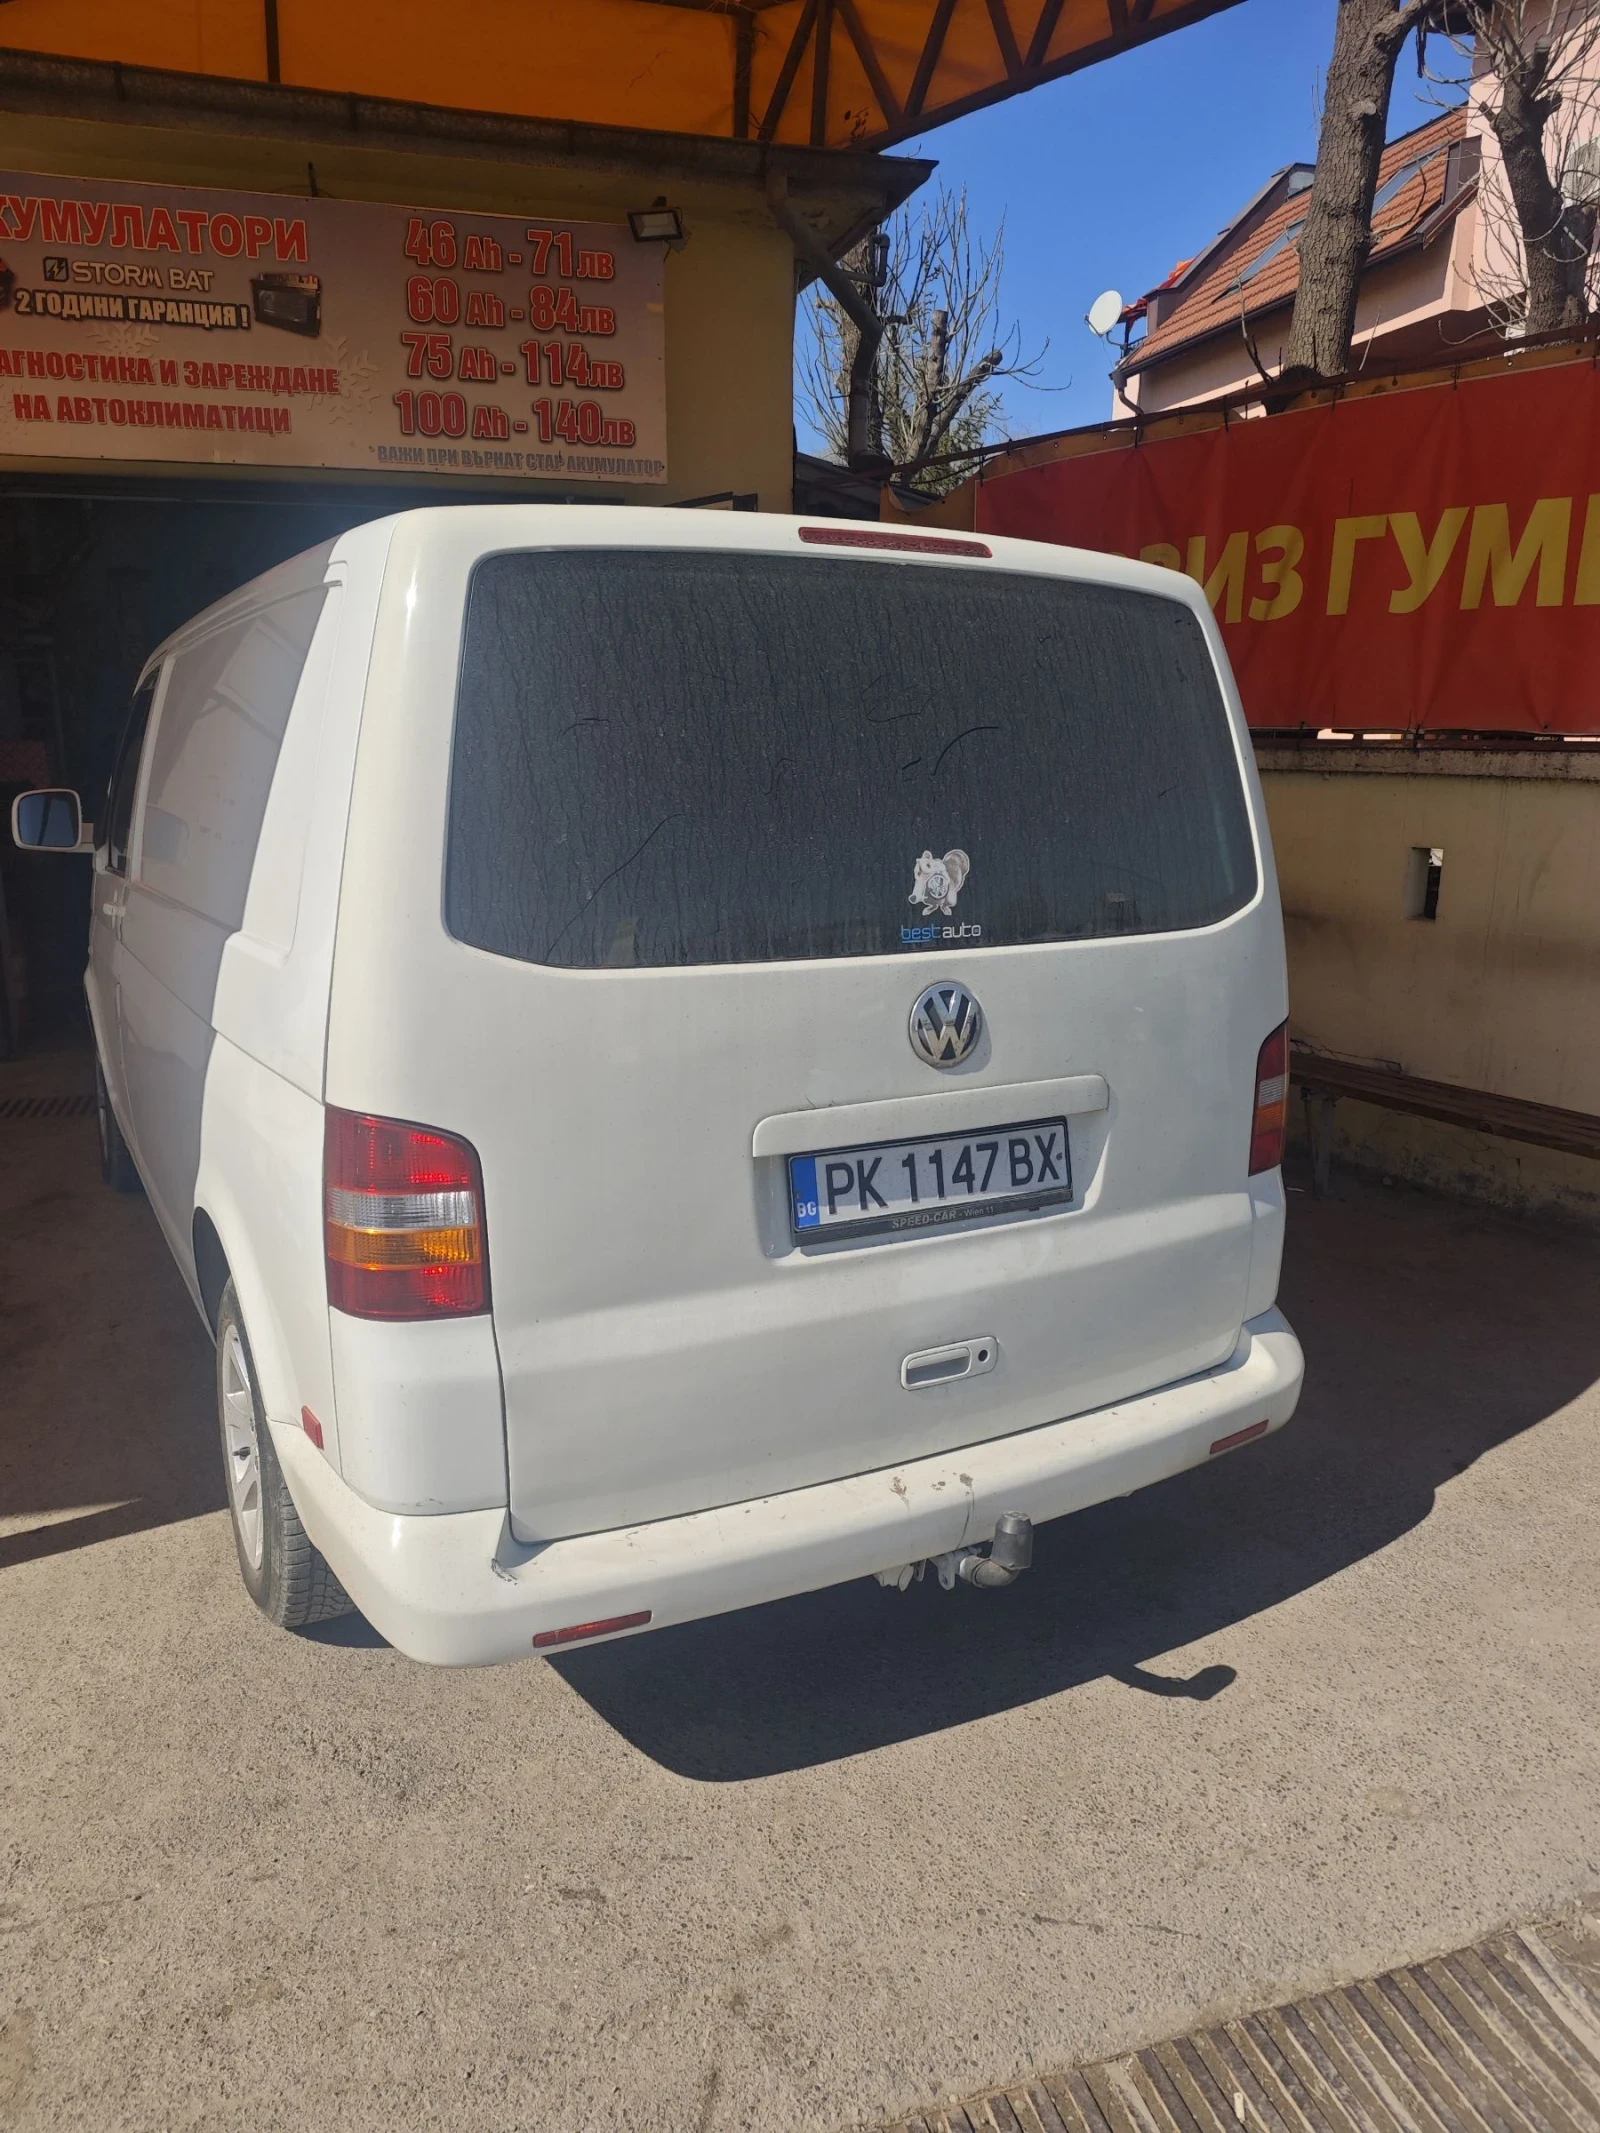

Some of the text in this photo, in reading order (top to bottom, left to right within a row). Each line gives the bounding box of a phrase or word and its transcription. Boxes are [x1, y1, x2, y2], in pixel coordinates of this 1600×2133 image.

[405, 219, 457, 267] 46
[464, 236, 502, 271] Ah
[71, 261, 214, 291] STORM BAT
[16, 291, 31, 313] 2
[36, 292, 124, 319] ГОДИНИ
[407, 276, 459, 323] 60
[466, 293, 504, 327] Ah
[159, 358, 179, 386] И
[183, 361, 342, 396] ЗАРЕЖДАНЕ
[402, 332, 453, 378] 75
[460, 348, 496, 380] Ah
[13, 394, 292, 436] НА АВТОКЛИМАТИЦИ
[394, 391, 467, 436] 100
[473, 406, 510, 439] Ah
[426, 448, 460, 467] ПРИ
[461, 450, 523, 470] ВЪРНАТ
[525, 453, 564, 472] СТАР
[566, 455, 664, 476] АКУМУЛАТОР
[796, 1132, 1061, 1218] BG PK 1147 BX
[892, 1209, 957, 1229] SPEED-CAR
[964, 1208, 984, 1217] Wien
